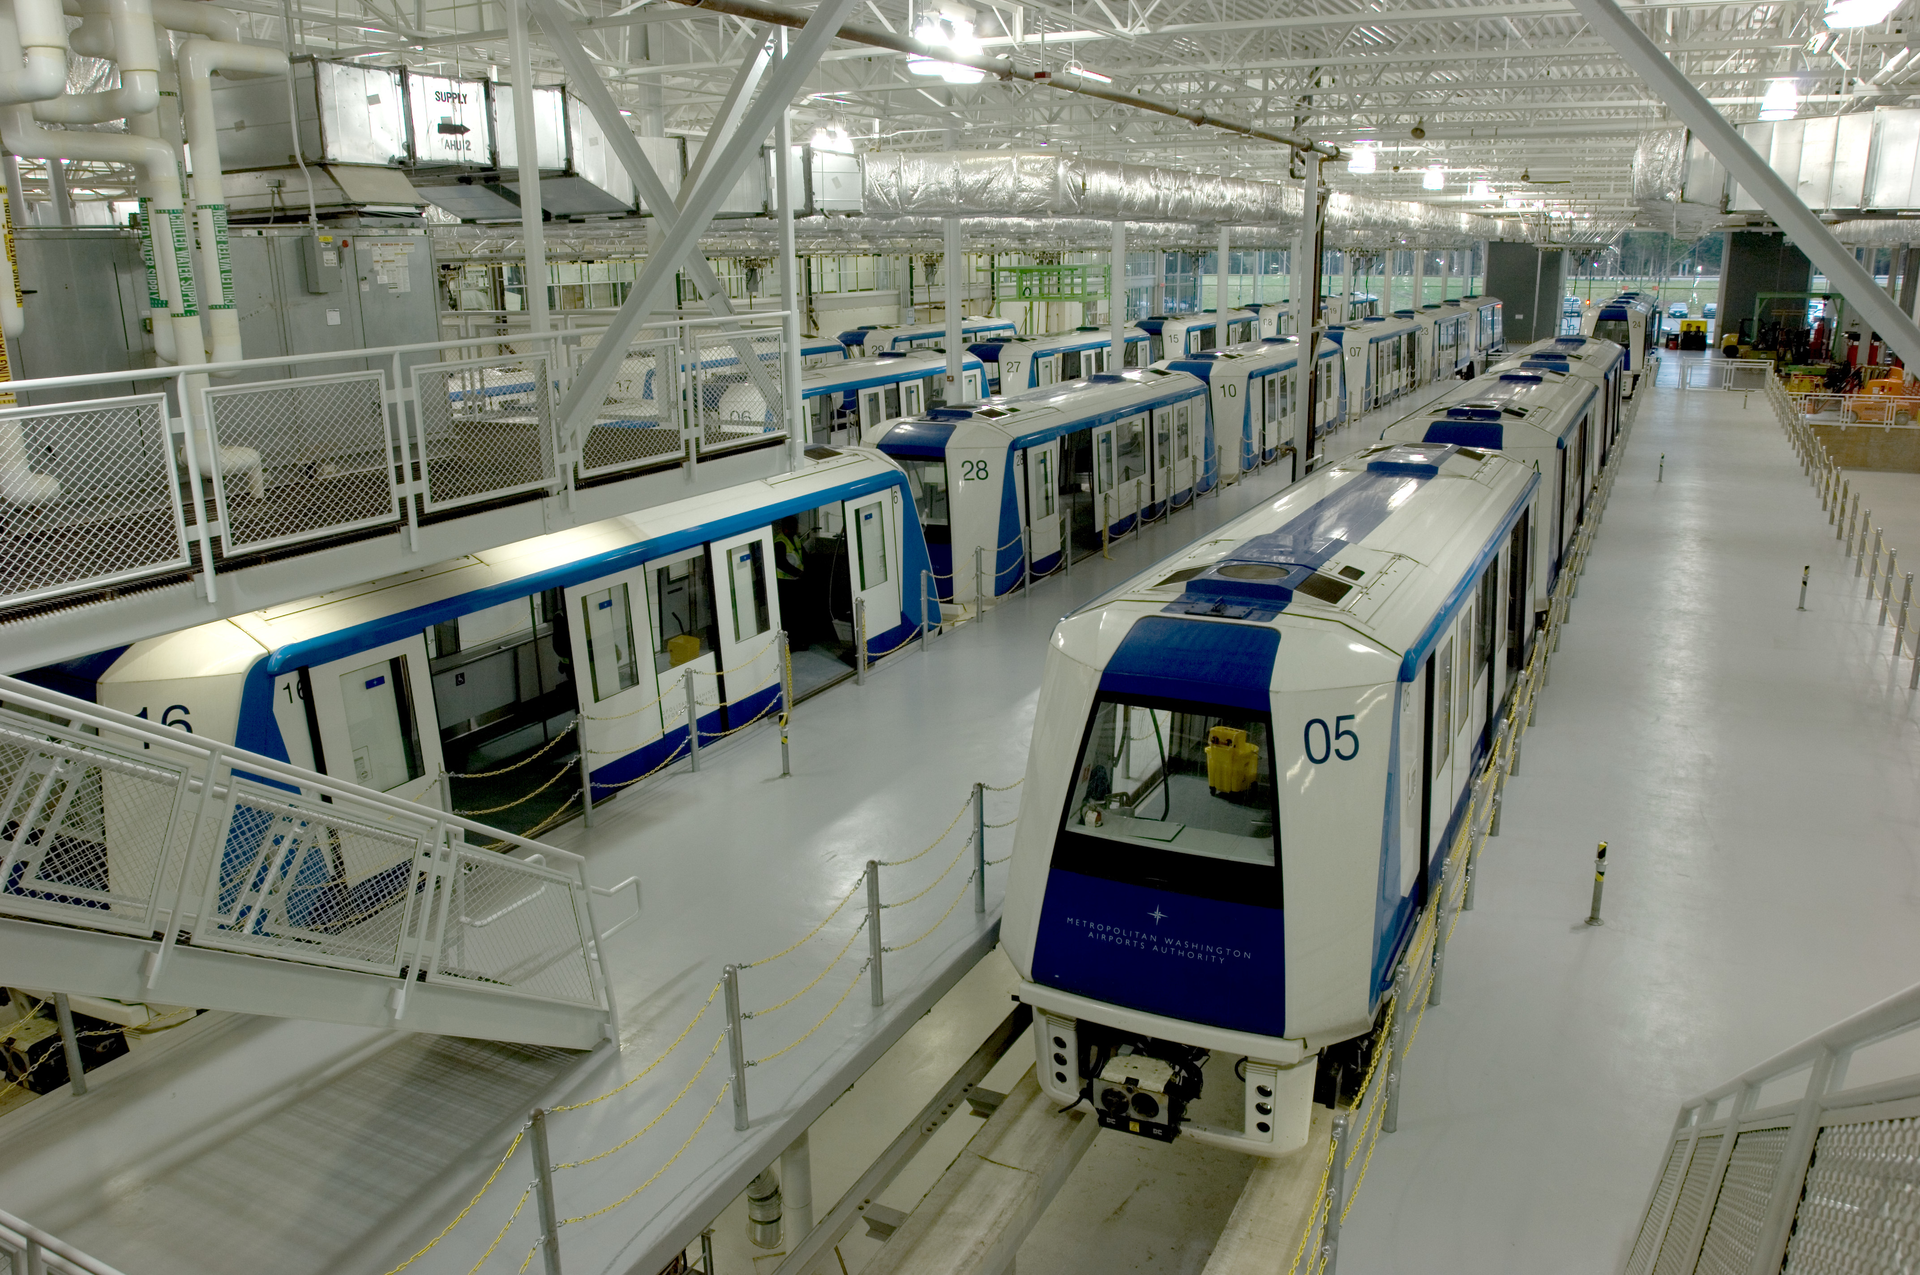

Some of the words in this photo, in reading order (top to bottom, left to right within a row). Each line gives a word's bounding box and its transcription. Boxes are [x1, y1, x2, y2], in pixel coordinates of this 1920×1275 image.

[435, 91, 467, 104] SUPPLY
[444, 139, 461, 151] AHU
[465, 140, 472, 151] 2
[169, 213, 188, 248] CHILLED
[212, 210, 229, 241] RETURN
[176, 251, 193, 279] WATER
[217, 243, 232, 271] WATER
[180, 280, 198, 311] SUPPLY
[221, 273, 237, 305] CHILLED
[1632, 321, 1641, 329] 24
[1168, 334, 1179, 343] 15
[871, 345, 885, 355] 29
[1349, 346, 1361, 357] 07
[1006, 361, 1021, 373] 27
[616, 379, 633, 392] 17
[1220, 383, 1237, 398] 10
[961, 459, 989, 481] 28
[1303, 714, 1360, 765] 05
[1066, 916, 1158, 942] METROPOLITAN
[1164, 936, 1252, 960] WASHINGTON
[1087, 931, 1145, 950] AIRPORTS
[1152, 944, 1225, 965] AUTHORITY
